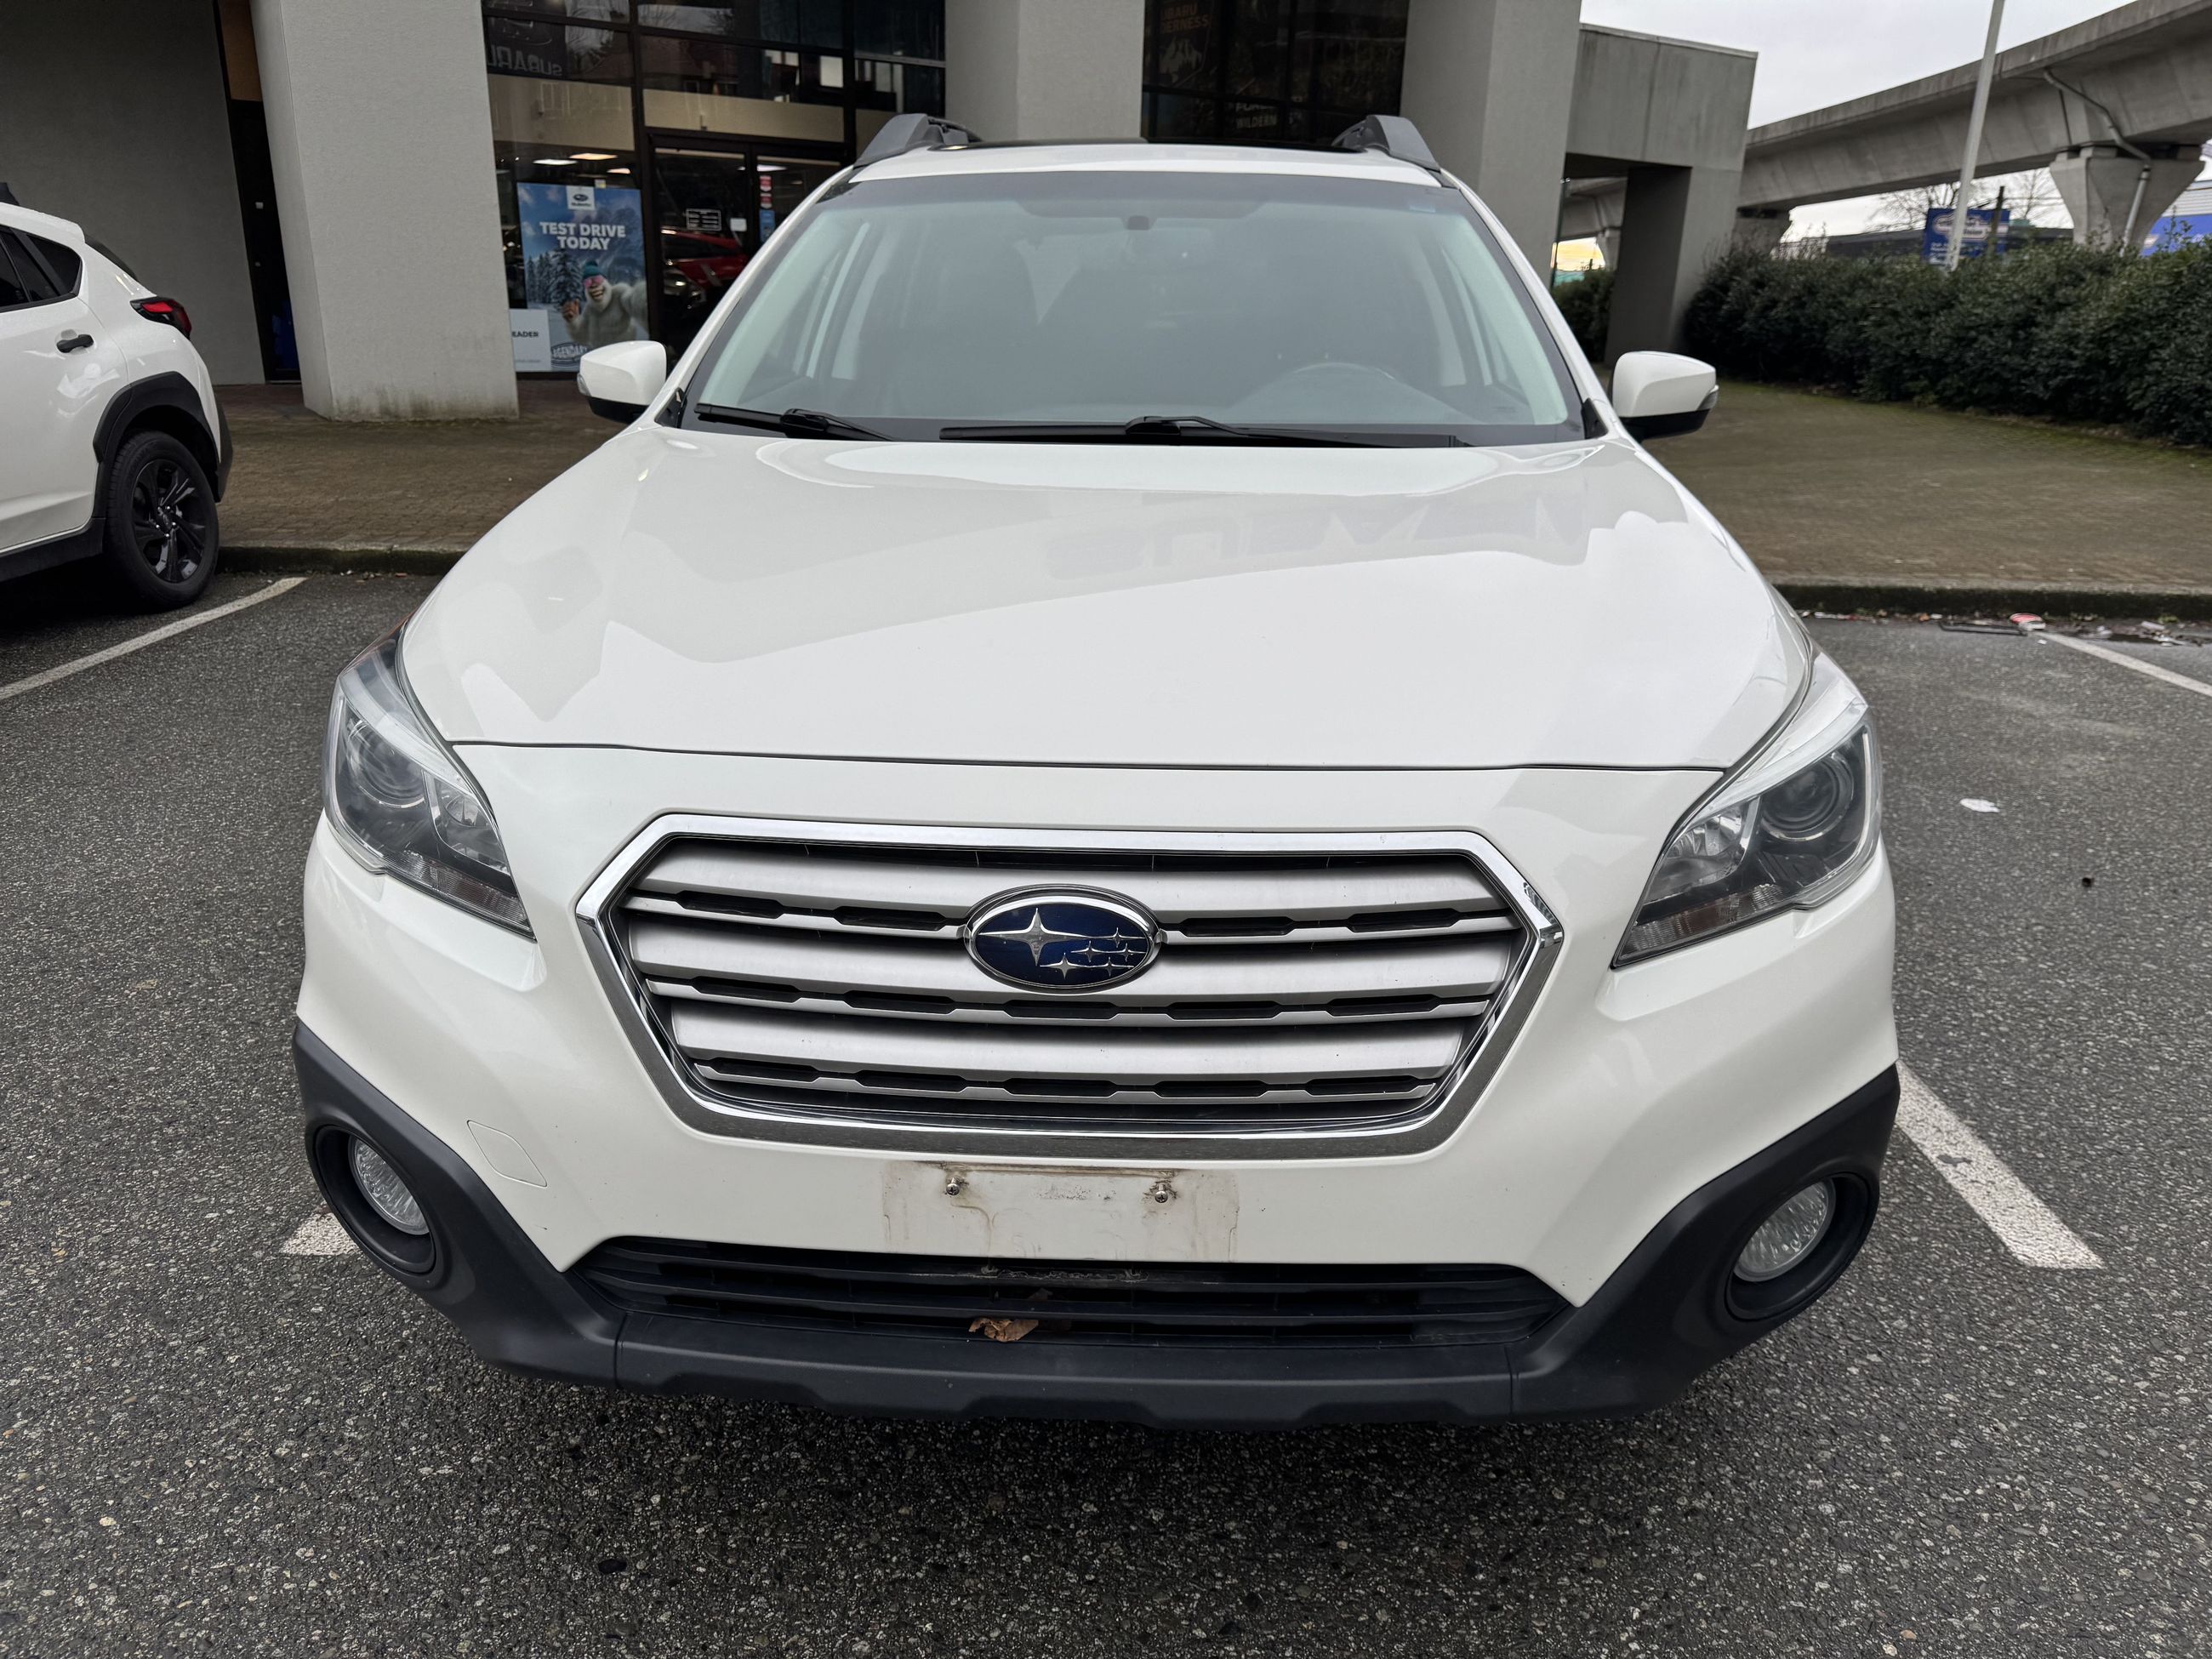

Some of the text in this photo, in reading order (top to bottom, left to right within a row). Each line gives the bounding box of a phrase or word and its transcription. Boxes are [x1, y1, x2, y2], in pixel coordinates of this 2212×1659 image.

[1160, 3, 1198, 20] UBARU
[539, 221, 626, 238] TEST DRIVE
[557, 236, 611, 250] TODAY
